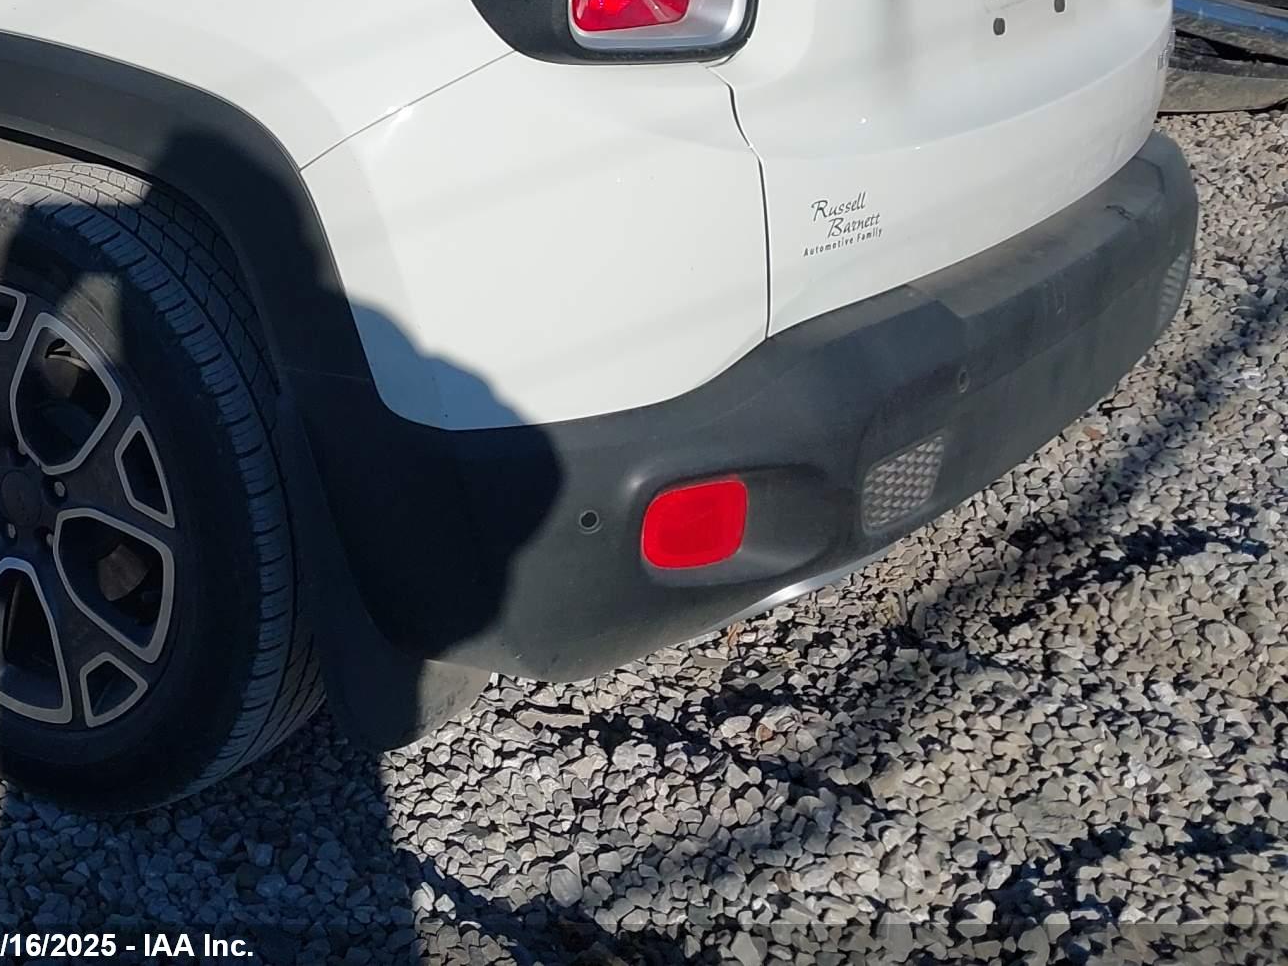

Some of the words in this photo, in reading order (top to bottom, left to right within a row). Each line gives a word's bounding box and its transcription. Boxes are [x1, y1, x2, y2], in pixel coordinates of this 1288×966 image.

[810, 191, 867, 222] Russell
[827, 212, 881, 239] Barnett
[803, 237, 854, 257] Automotive
[856, 227, 883, 243] Family
